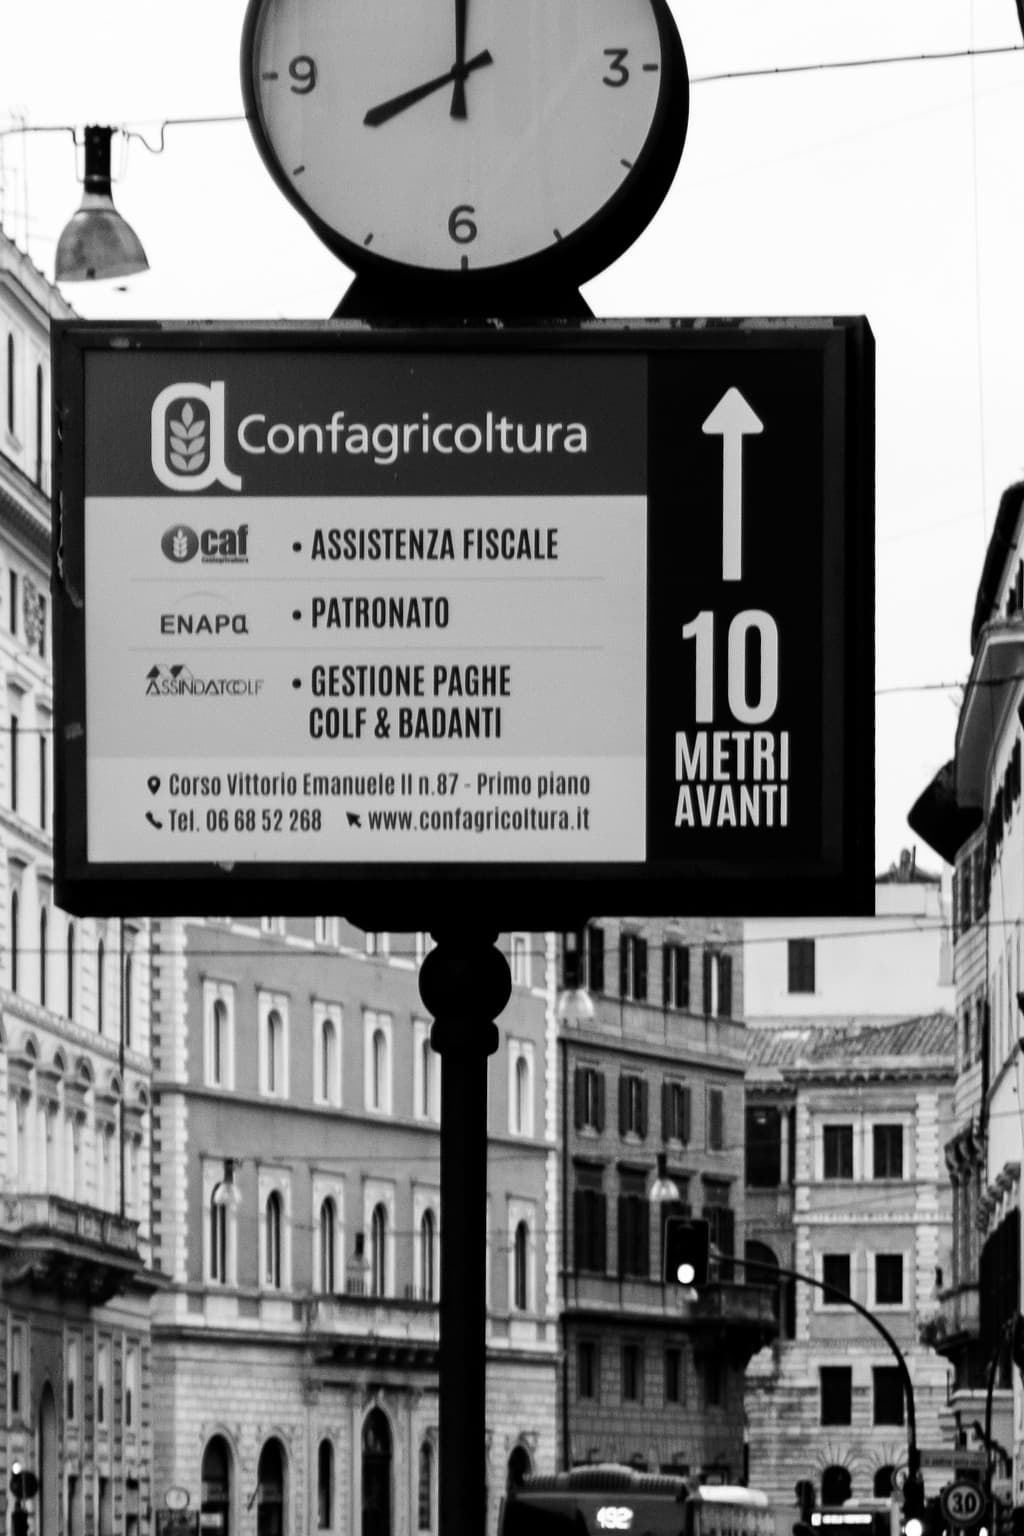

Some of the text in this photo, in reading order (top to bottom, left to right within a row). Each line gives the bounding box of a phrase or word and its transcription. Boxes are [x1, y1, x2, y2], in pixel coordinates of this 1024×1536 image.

[287, 55, 318, 95] 9
[602, 47, 630, 88] 3
[447, 204, 478, 244] 6
[236, 409, 589, 466] Confagricoltura
[200, 523, 249, 556] caf
[310, 527, 559, 561] ASSISTENZA FISCALE
[311, 596, 450, 629] PATRONATO
[310, 664, 512, 698] GESTIONE PAGHE
[679, 608, 782, 727] 10
[308, 706, 502, 740] COLF & BADANTI
[674, 730, 790, 783] METRI
[168, 772, 222, 797] Corso
[226, 771, 298, 797] Vittorio
[303, 772, 396, 797] Emanuele
[418, 772, 460, 797] n.87
[477, 770, 533, 797] Primo
[537, 770, 591, 799] piano
[168, 806, 590, 834] Tel. 06 68 52 268 www.confagricoltura.it
[673, 783, 790, 830] AVANTI
[951, 1491, 977, 1518] 30
